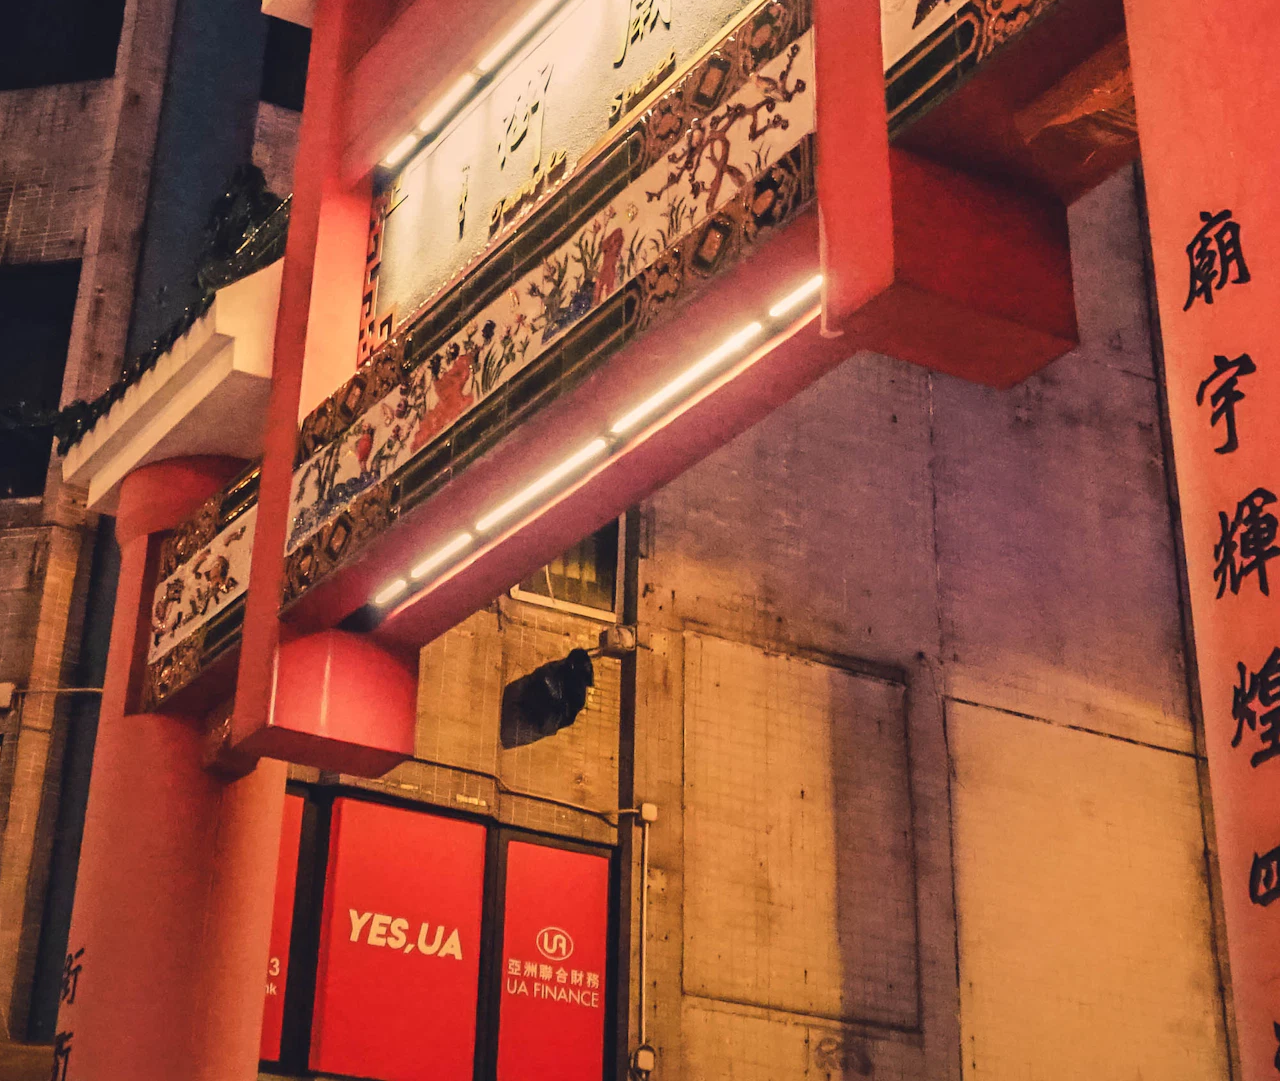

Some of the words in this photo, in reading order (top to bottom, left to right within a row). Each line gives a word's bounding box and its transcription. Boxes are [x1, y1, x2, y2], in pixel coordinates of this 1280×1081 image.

[508, 958, 600, 989] 亞洲聯合財務
[507, 978, 529, 996] UA
[534, 982, 600, 1008] FINANCE
